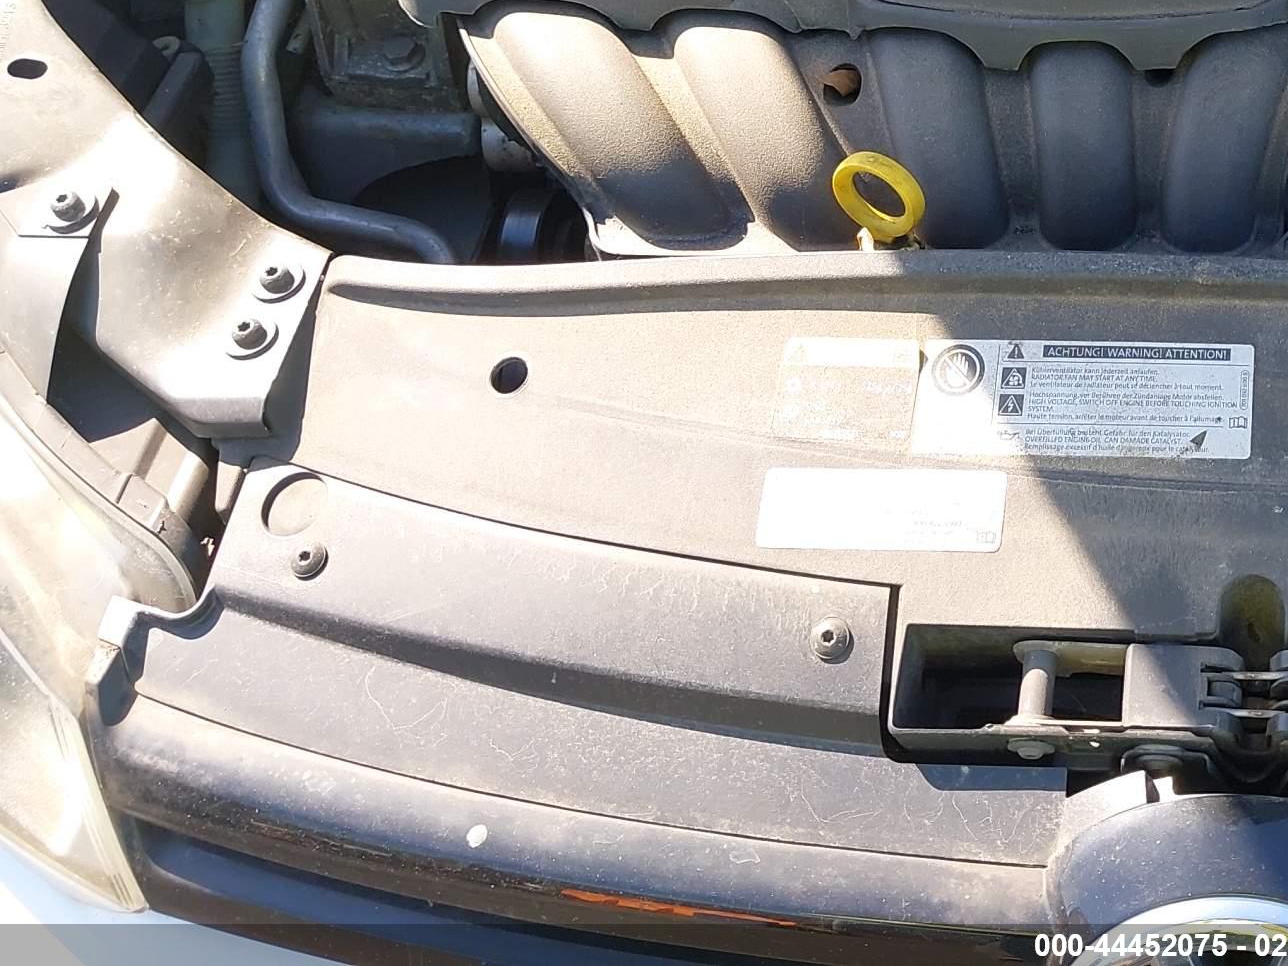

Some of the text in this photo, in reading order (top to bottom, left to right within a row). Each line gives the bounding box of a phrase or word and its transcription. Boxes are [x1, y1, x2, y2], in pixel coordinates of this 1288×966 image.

[1047, 347, 1227, 360] ACHTUNG! WARNING! ATTENTION!
[1170, 400, 1206, 408] TOUCHING
